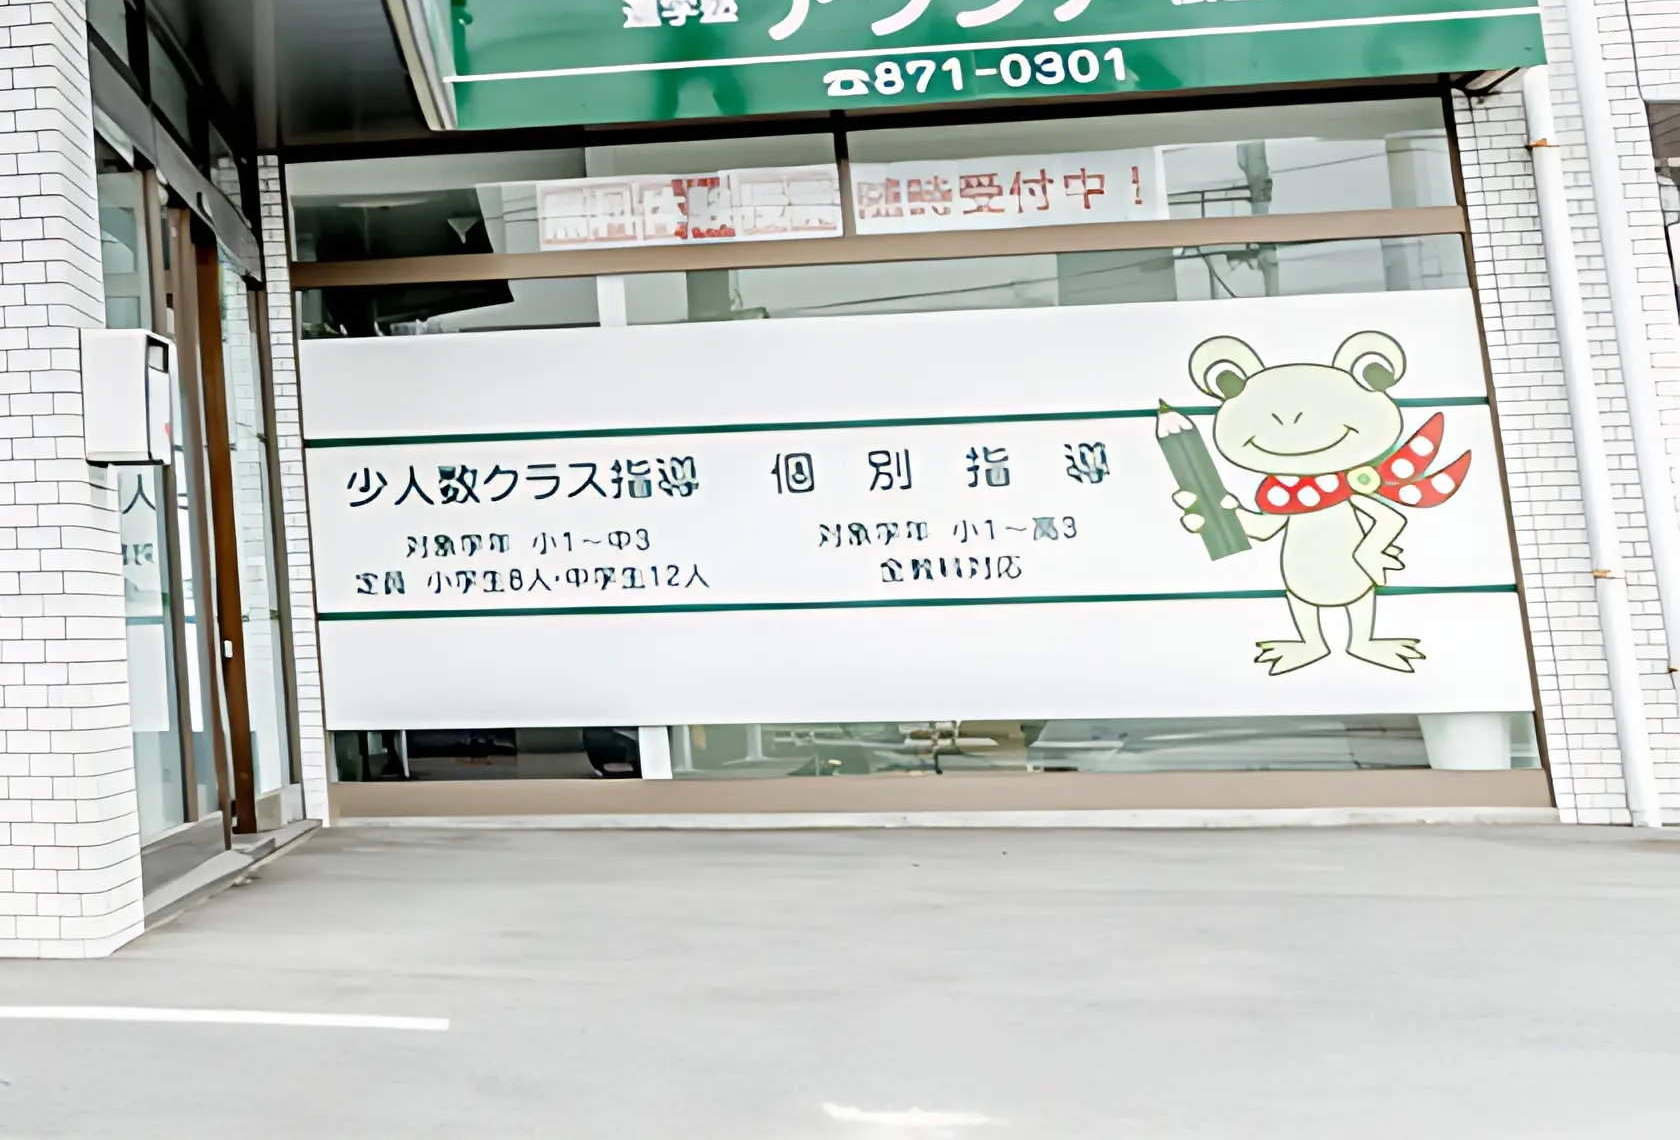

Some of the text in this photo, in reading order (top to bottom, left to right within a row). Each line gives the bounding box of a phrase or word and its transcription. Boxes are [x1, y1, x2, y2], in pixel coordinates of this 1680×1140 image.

[872, 46, 1126, 96] 871-0301
[346, 455, 700, 508] 少人数クラス指導
